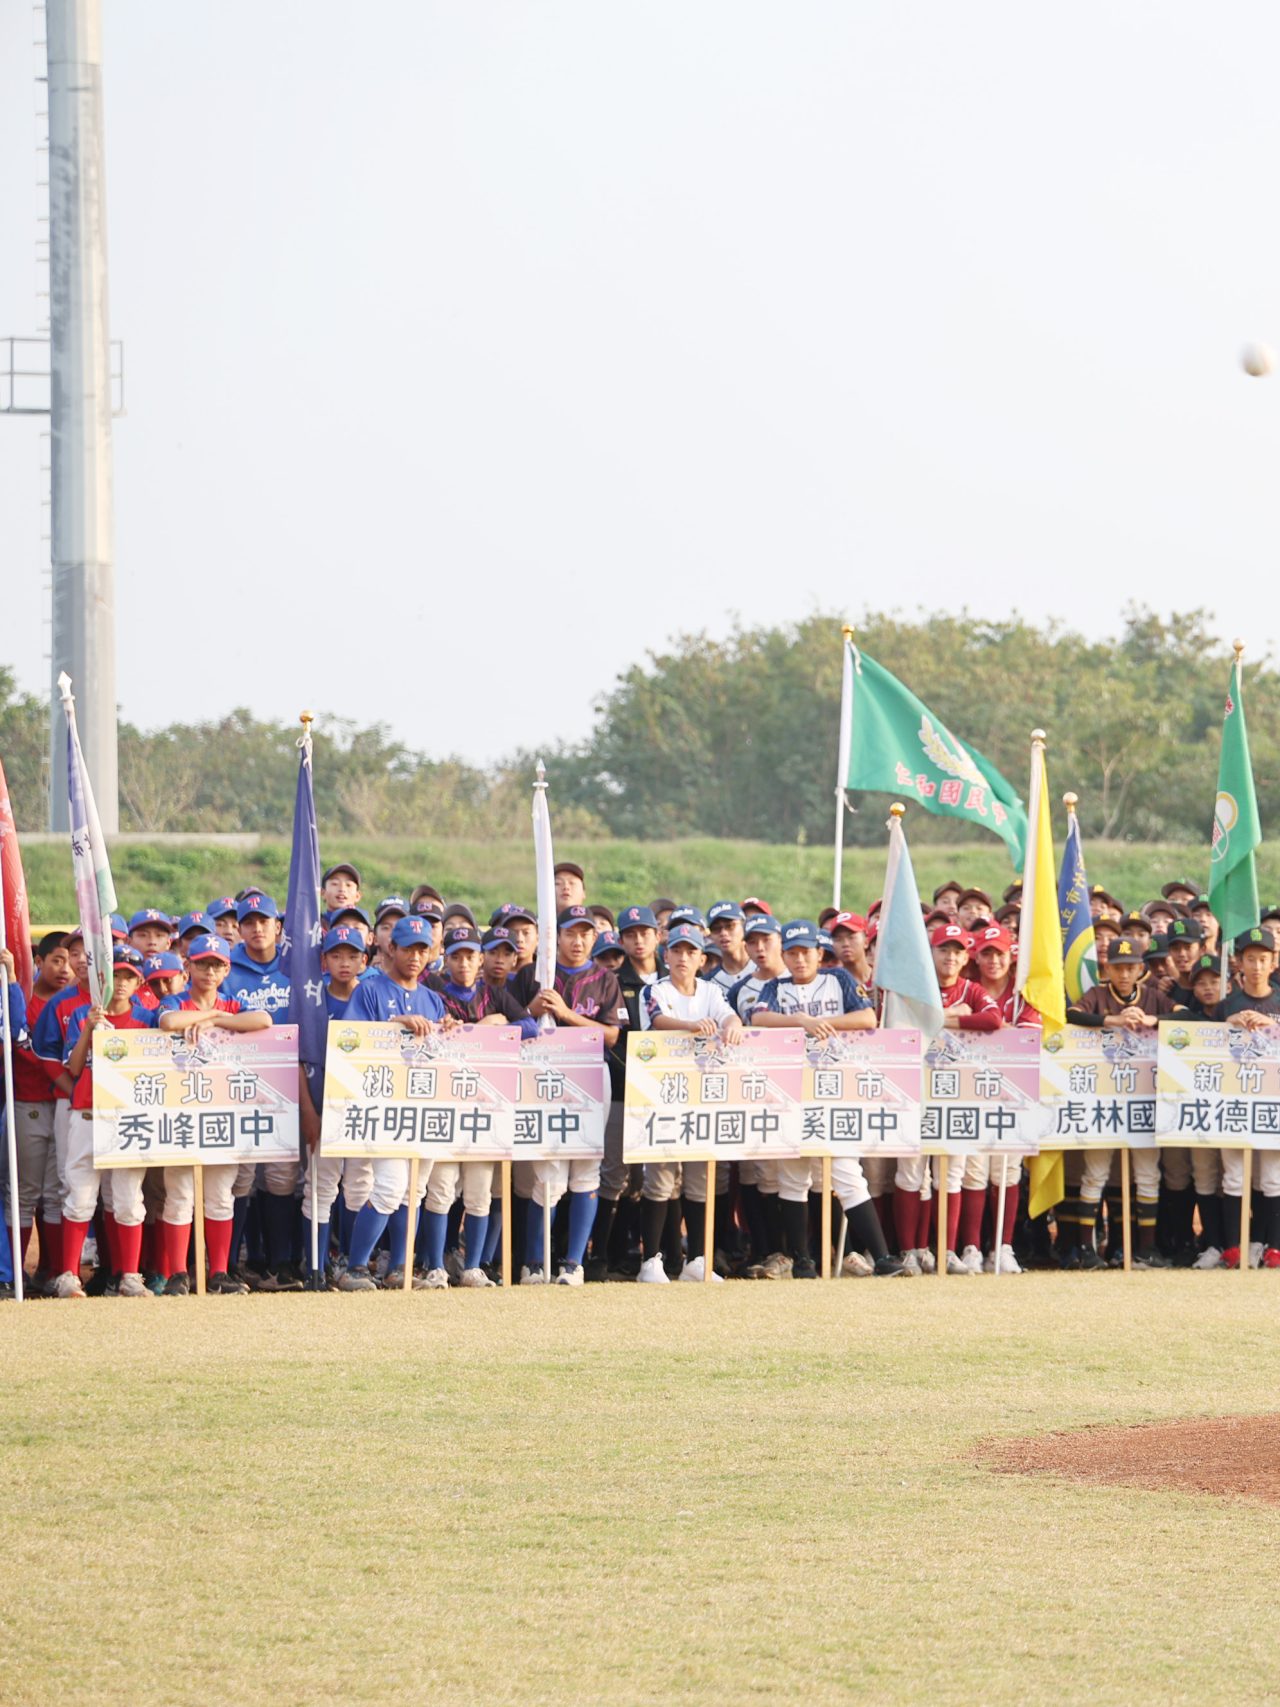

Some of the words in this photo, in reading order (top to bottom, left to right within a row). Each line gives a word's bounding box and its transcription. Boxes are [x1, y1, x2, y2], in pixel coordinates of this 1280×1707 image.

[236, 983, 291, 1003] Basebal
[134, 1072, 258, 1105] 新北市
[363, 1066, 480, 1100] 桃園市
[516, 1071, 565, 1100] 市
[660, 1071, 768, 1104] 桃園市
[814, 1069, 886, 1101] 園市
[930, 1070, 1003, 1100] 園市
[1070, 1064, 1157, 1094] 新竹
[118, 1109, 274, 1150] 秀峰國中
[344, 1104, 492, 1144] 新明國中
[645, 1109, 780, 1146] 仁和國中
